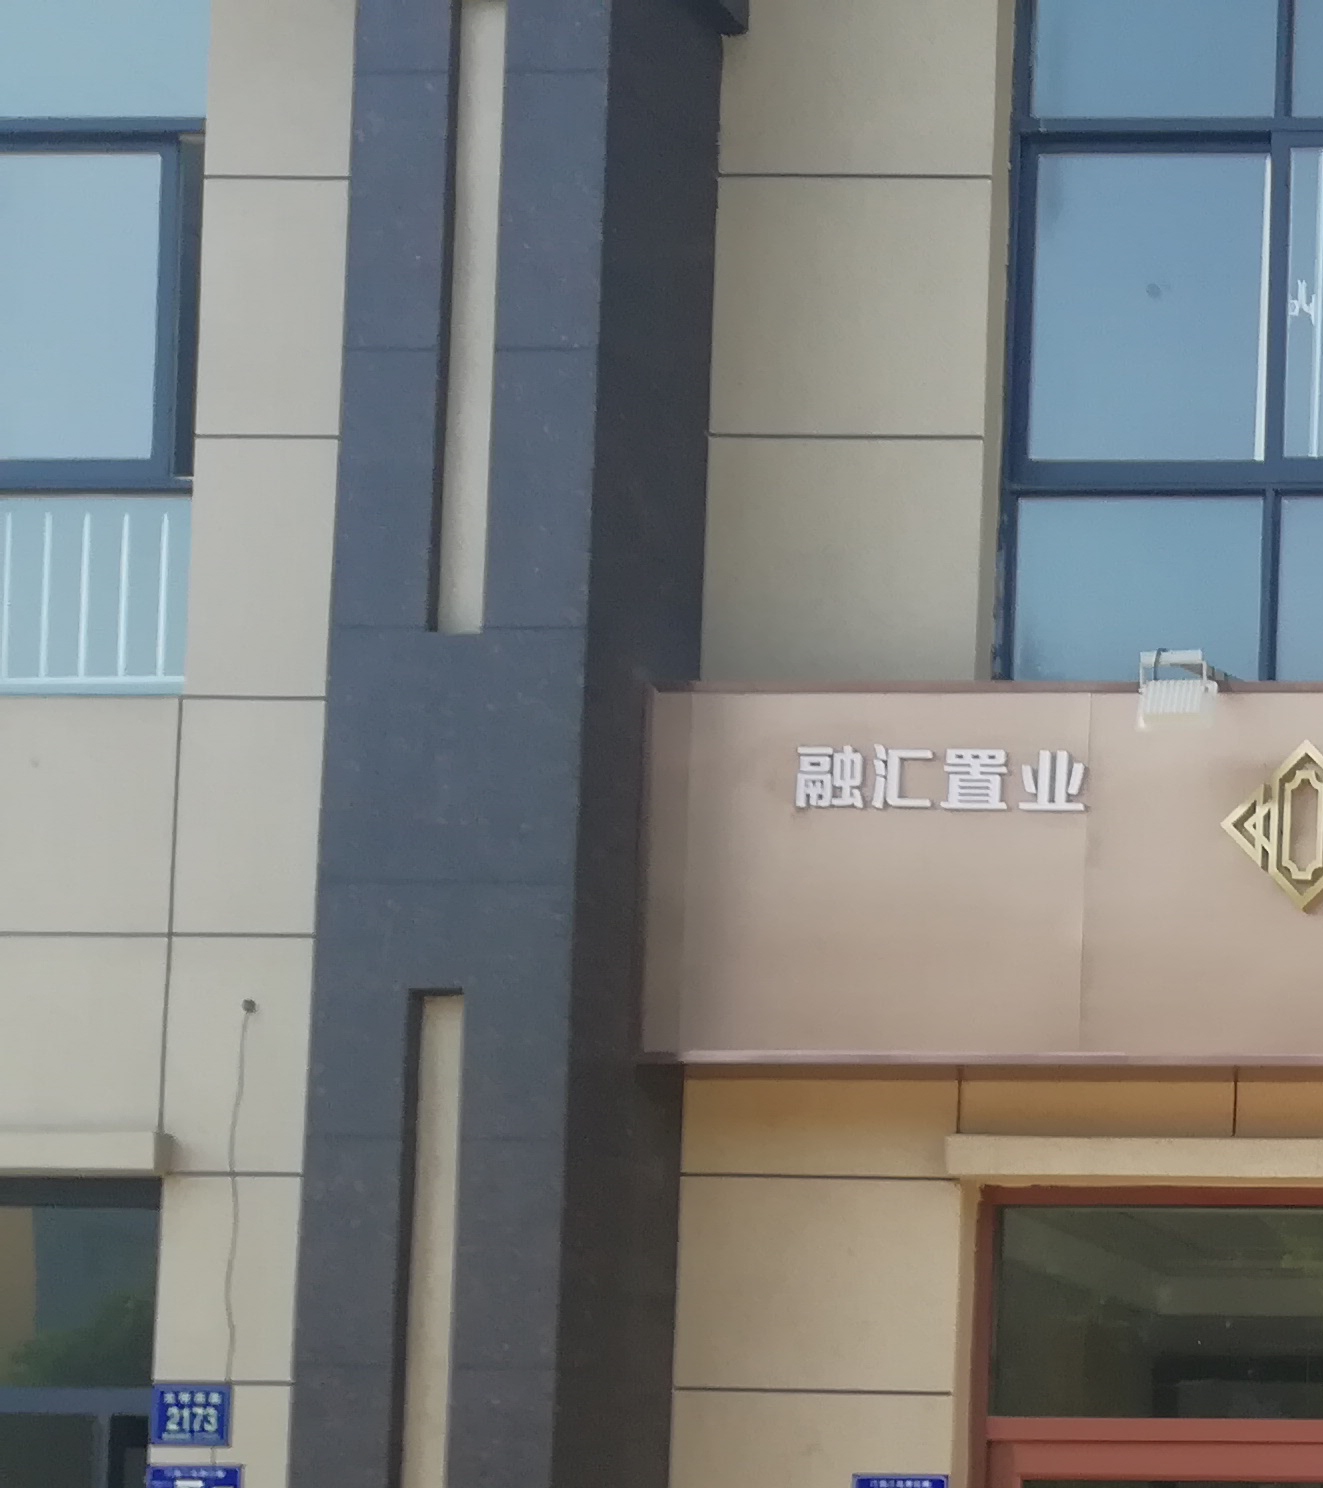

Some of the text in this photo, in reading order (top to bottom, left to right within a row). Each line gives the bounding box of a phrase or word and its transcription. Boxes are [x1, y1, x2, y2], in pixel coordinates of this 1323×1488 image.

[795, 743, 1087, 811] 融汇置业
[166, 1406, 218, 1432] 2173
